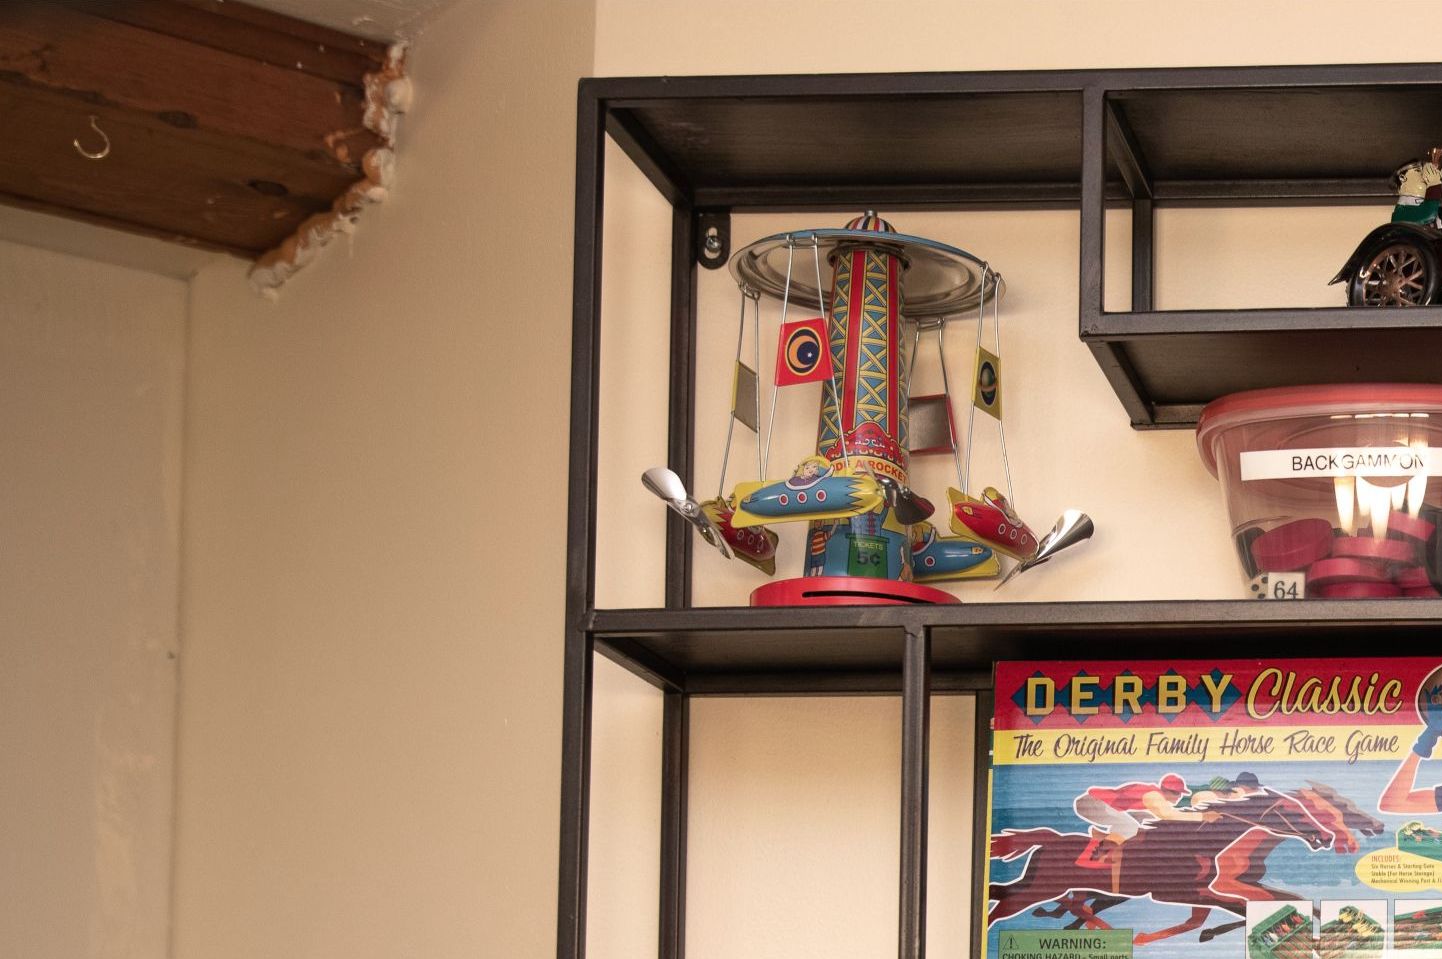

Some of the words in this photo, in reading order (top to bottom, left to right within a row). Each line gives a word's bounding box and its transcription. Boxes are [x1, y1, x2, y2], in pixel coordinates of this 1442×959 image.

[1291, 453, 1425, 472] BACKGAMMON
[868, 461, 907, 484] ROCKET
[854, 540, 884, 551] TICKETS
[1273, 580, 1299, 599] 64
[1026, 674, 1233, 716] DERBY
[1247, 667, 1402, 720] Classic
[1013, 733, 1044, 759] The
[1054, 733, 1137, 762] Original
[1145, 732, 1210, 762] Family
[1219, 729, 1275, 756] Horse
[1283, 729, 1336, 756] Race
[1345, 729, 1400, 764] Game
[1371, 855, 1400, 863] INCLUDES
[1039, 938, 1106, 950] WARNING:
